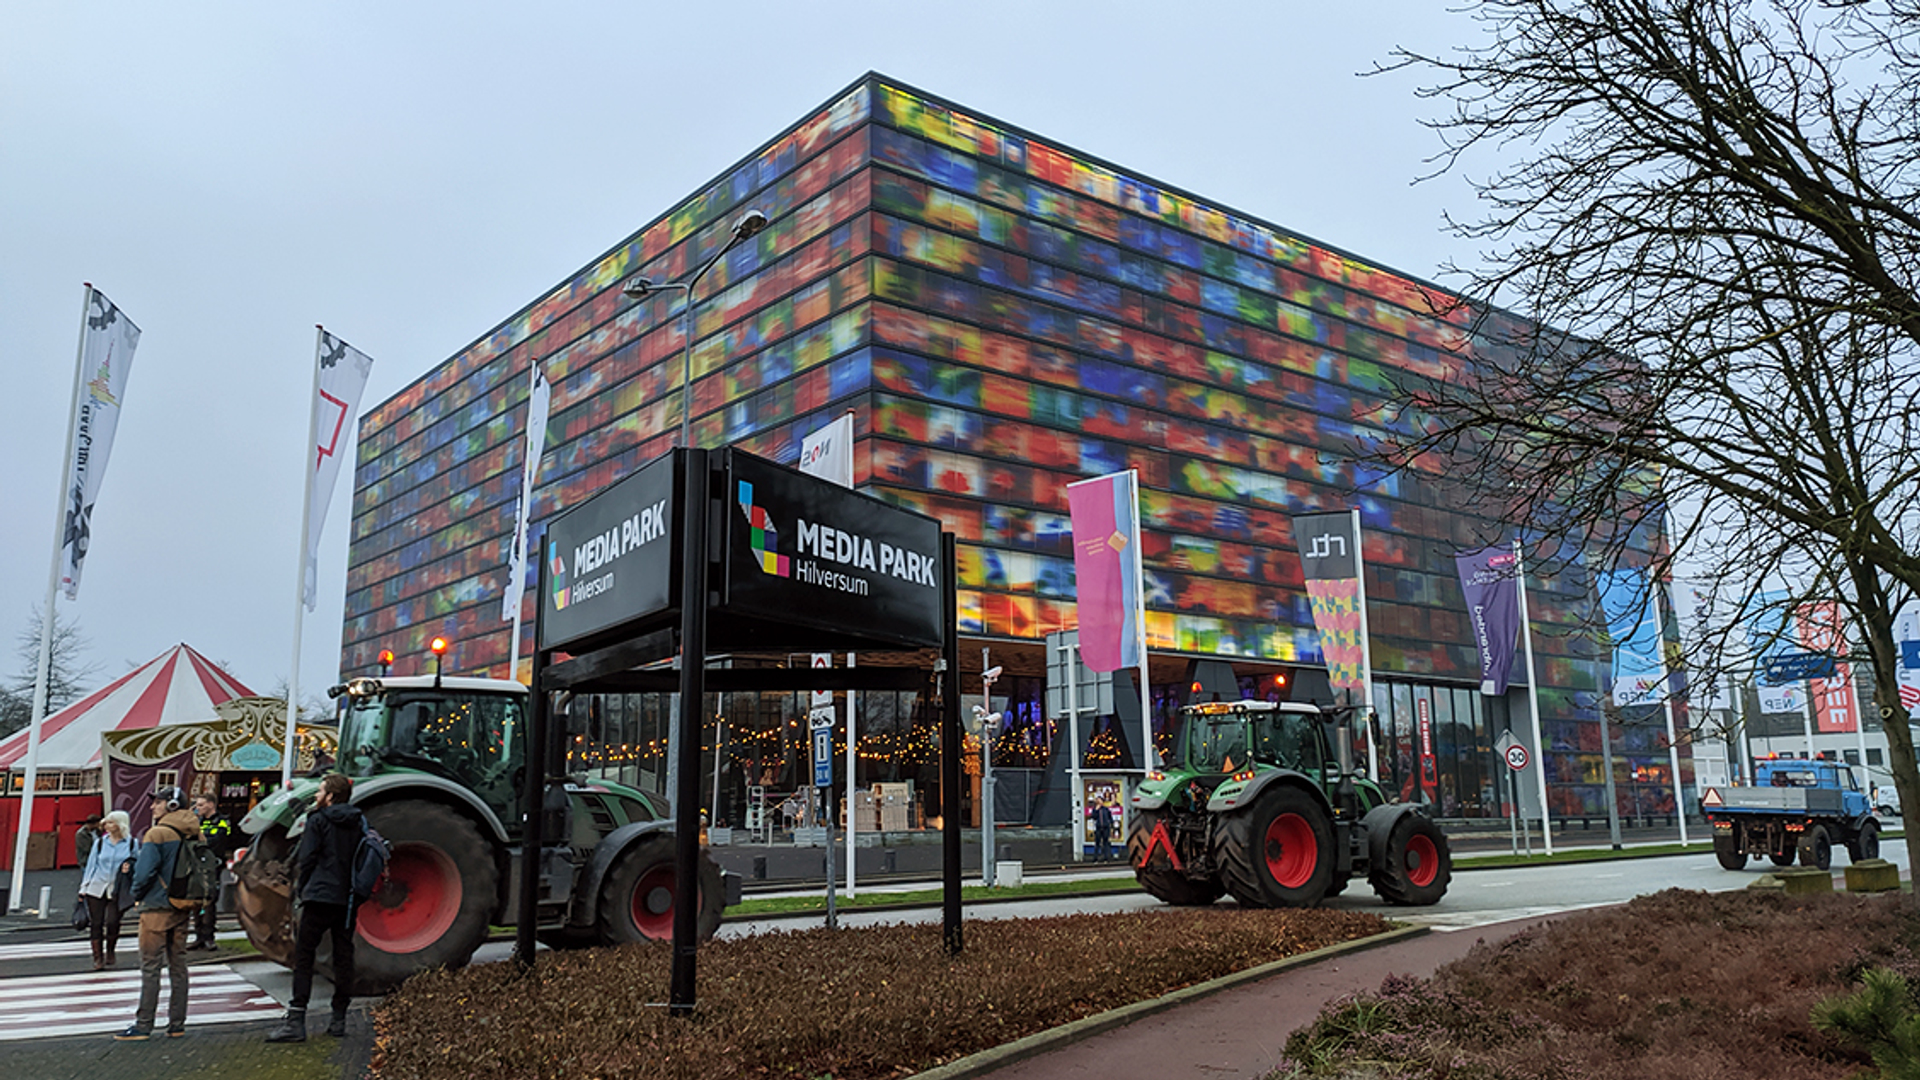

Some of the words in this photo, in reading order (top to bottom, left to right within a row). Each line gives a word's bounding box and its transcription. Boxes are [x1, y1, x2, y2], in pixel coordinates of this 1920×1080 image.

[573, 526, 620, 578] MEDIA
[621, 499, 666, 555] PARK
[797, 518, 877, 572] MEDIA
[880, 542, 936, 588] PARK
[570, 572, 614, 605] Hilversum
[796, 558, 869, 596] Hilversum
[1510, 751, 1526, 763] 30
